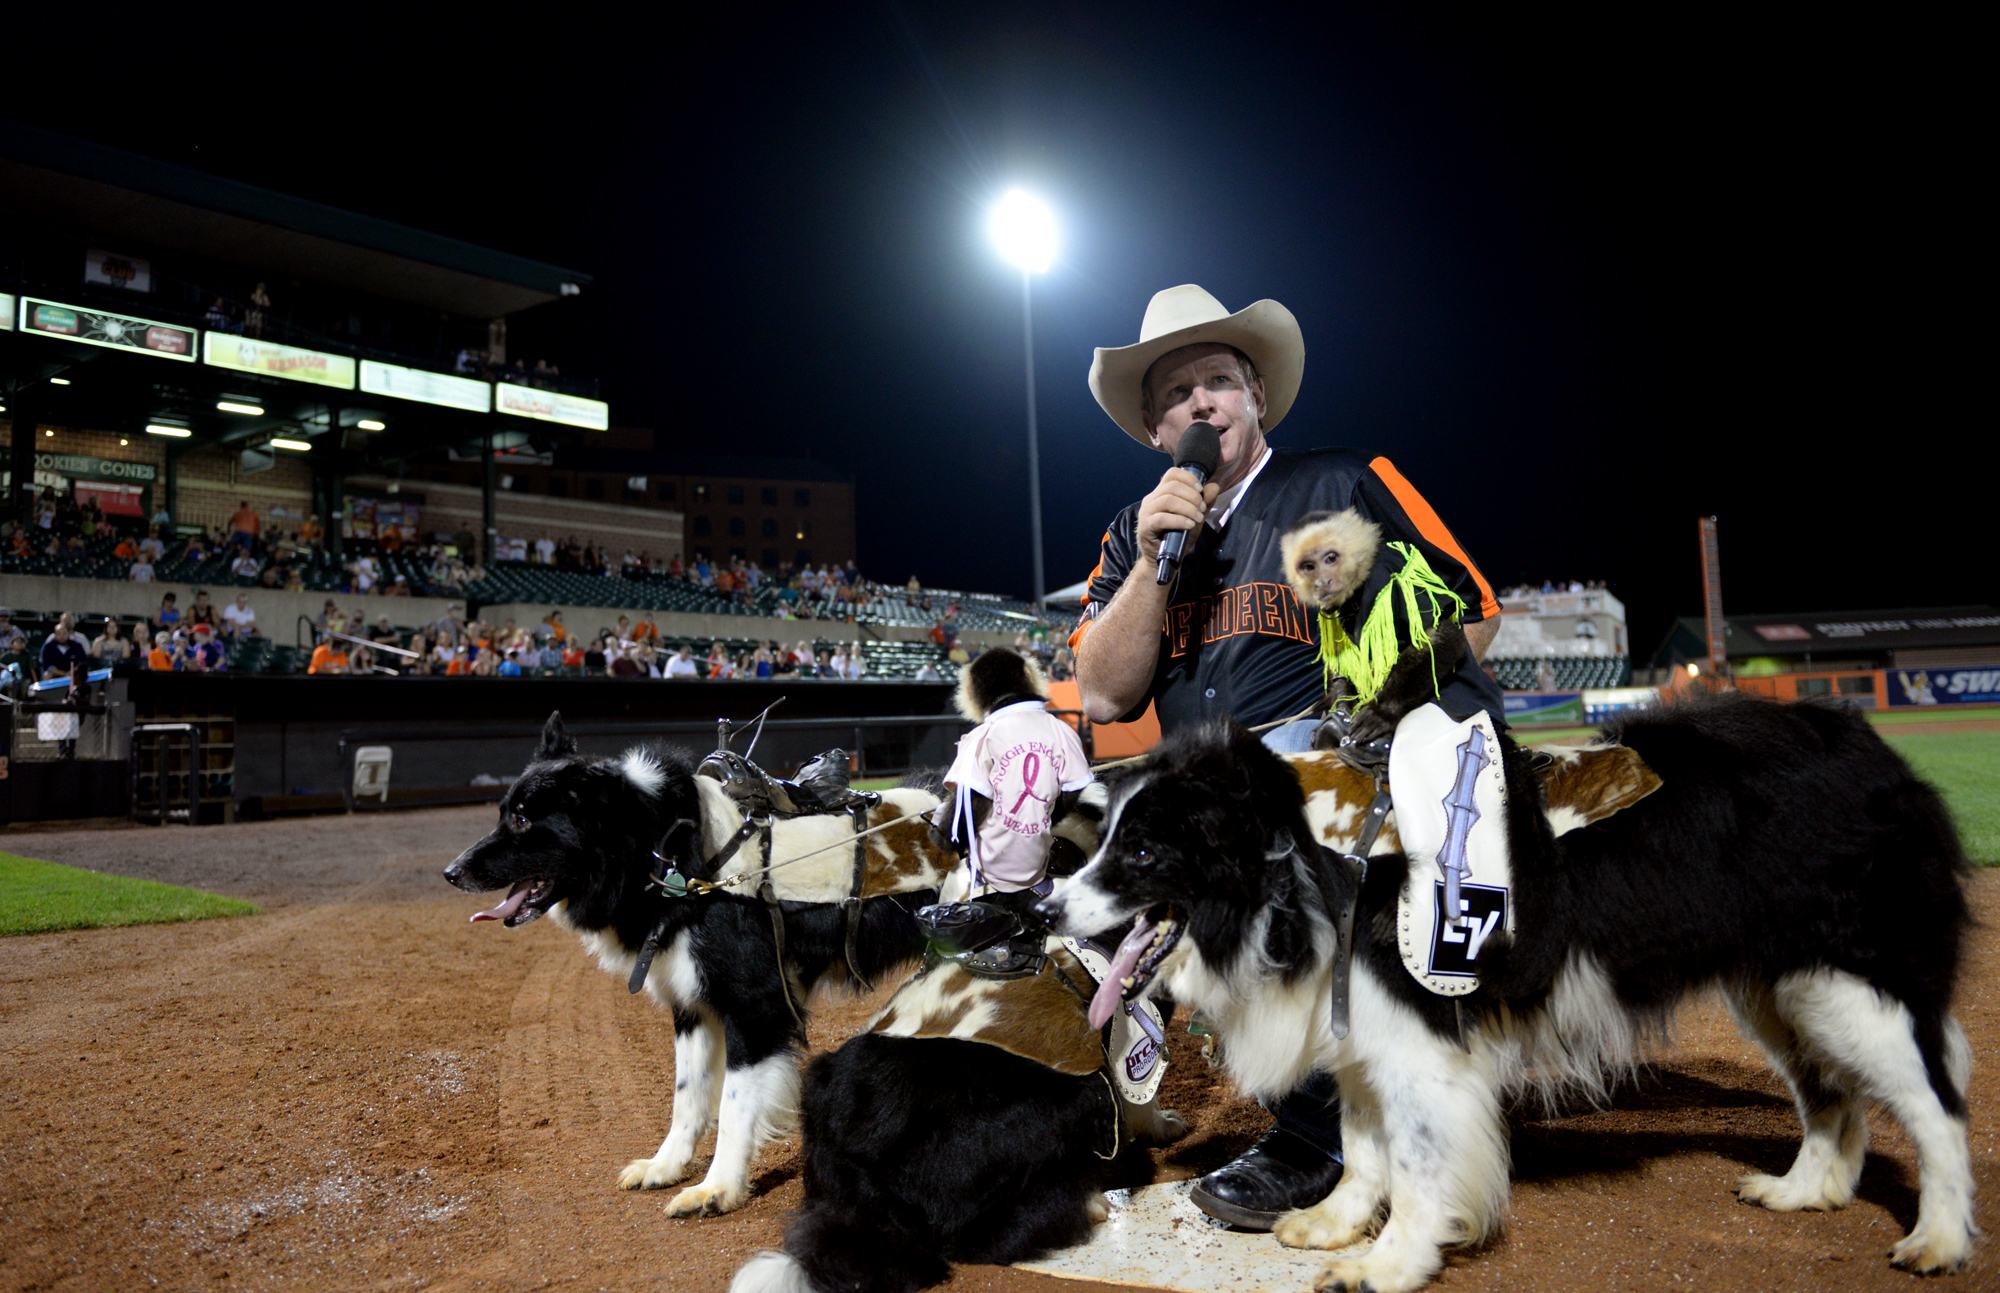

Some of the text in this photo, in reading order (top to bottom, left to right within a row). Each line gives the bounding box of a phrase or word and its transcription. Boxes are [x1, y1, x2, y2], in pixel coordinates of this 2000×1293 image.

[100, 461, 155, 480] CONES
[1162, 582, 1314, 658] ERDEEN
[993, 744, 1025, 783] TOUGH
[1003, 815, 1039, 834] WEAR
